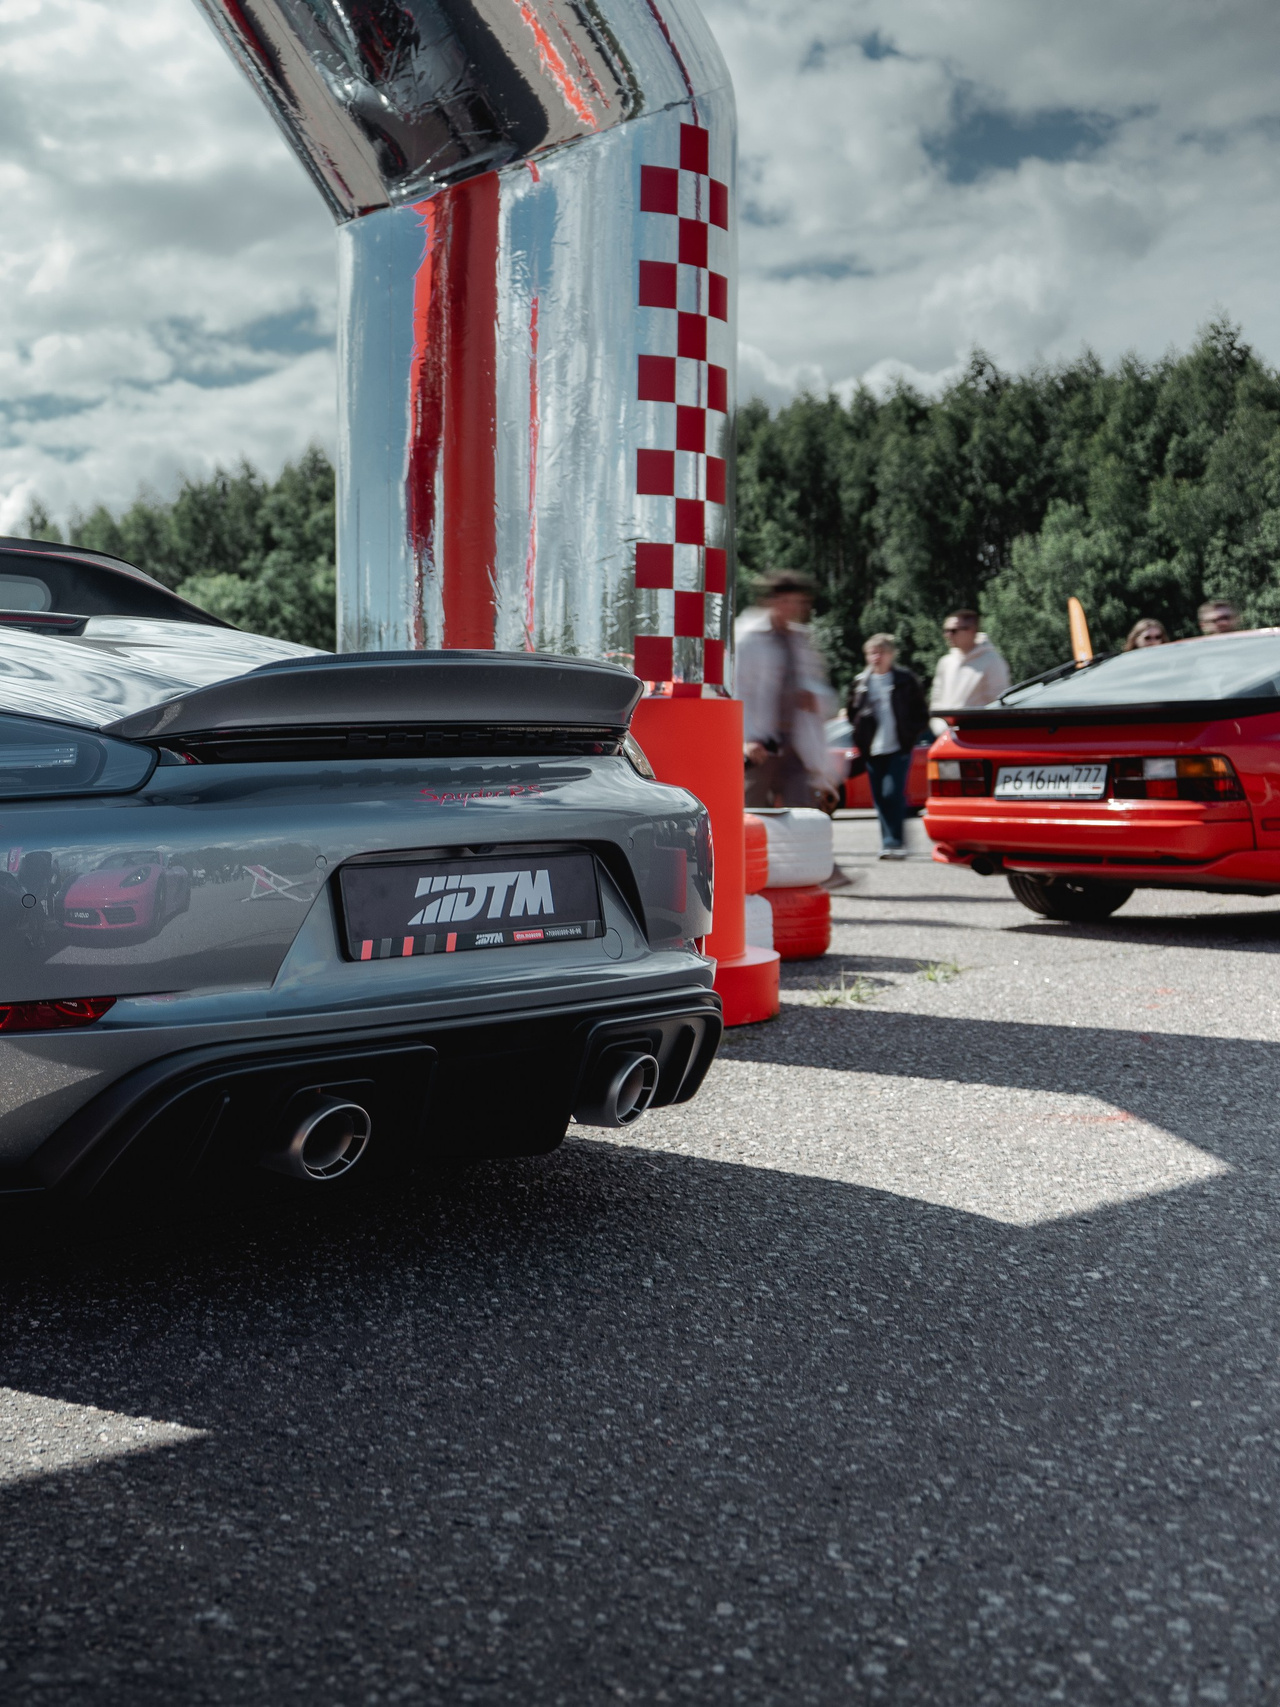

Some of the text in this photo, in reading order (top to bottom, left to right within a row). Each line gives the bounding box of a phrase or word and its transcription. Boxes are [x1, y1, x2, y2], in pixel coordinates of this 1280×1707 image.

[1074, 767, 1102, 783] 777
[415, 784, 544, 807] Spyder RS
[408, 869, 555, 926] DTM
